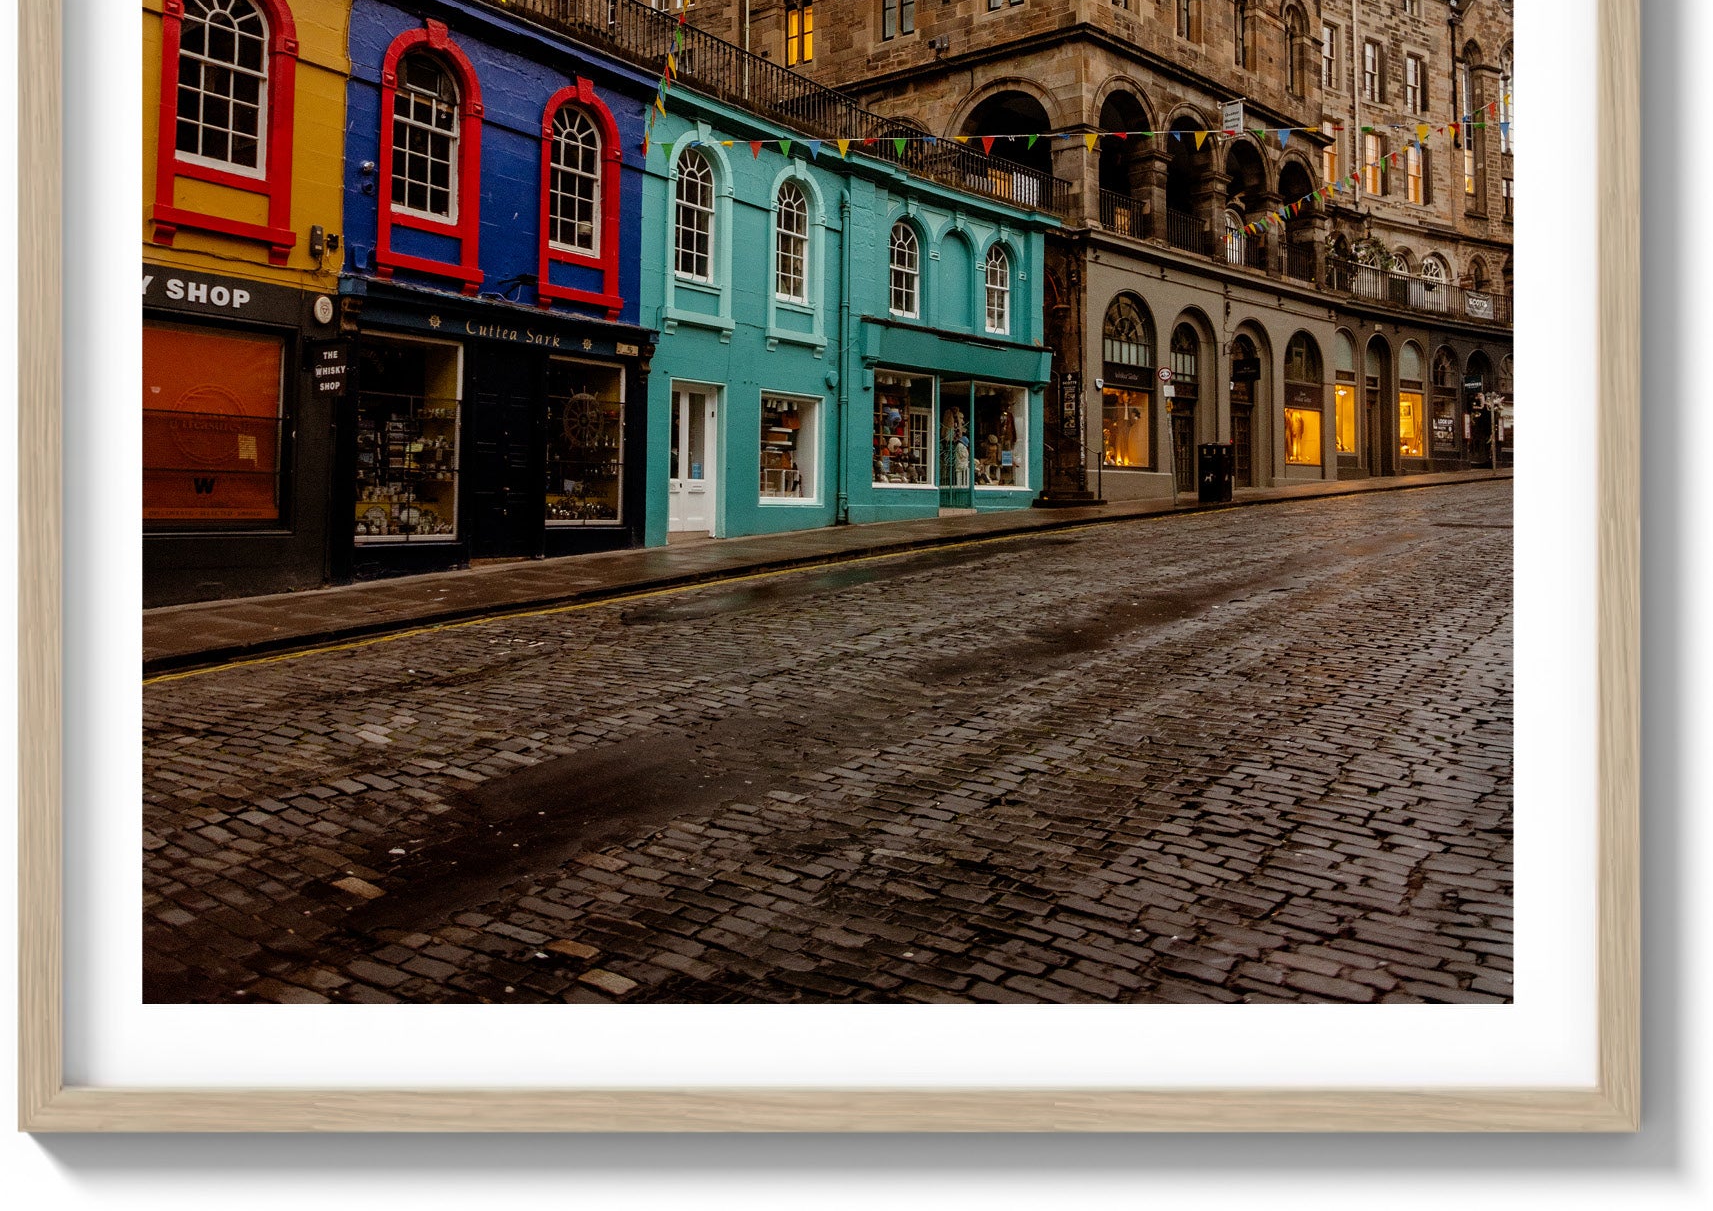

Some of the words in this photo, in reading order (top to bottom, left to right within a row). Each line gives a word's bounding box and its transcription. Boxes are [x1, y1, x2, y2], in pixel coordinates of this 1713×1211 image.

[166, 278, 250, 308] SHOP
[465, 319, 518, 341] Cuttea
[525, 328, 561, 348] Sark
[323, 350, 339, 359] THE
[315, 365, 346, 377] WHISKY
[319, 381, 341, 391] SHOP
[194, 477, 215, 494] W
